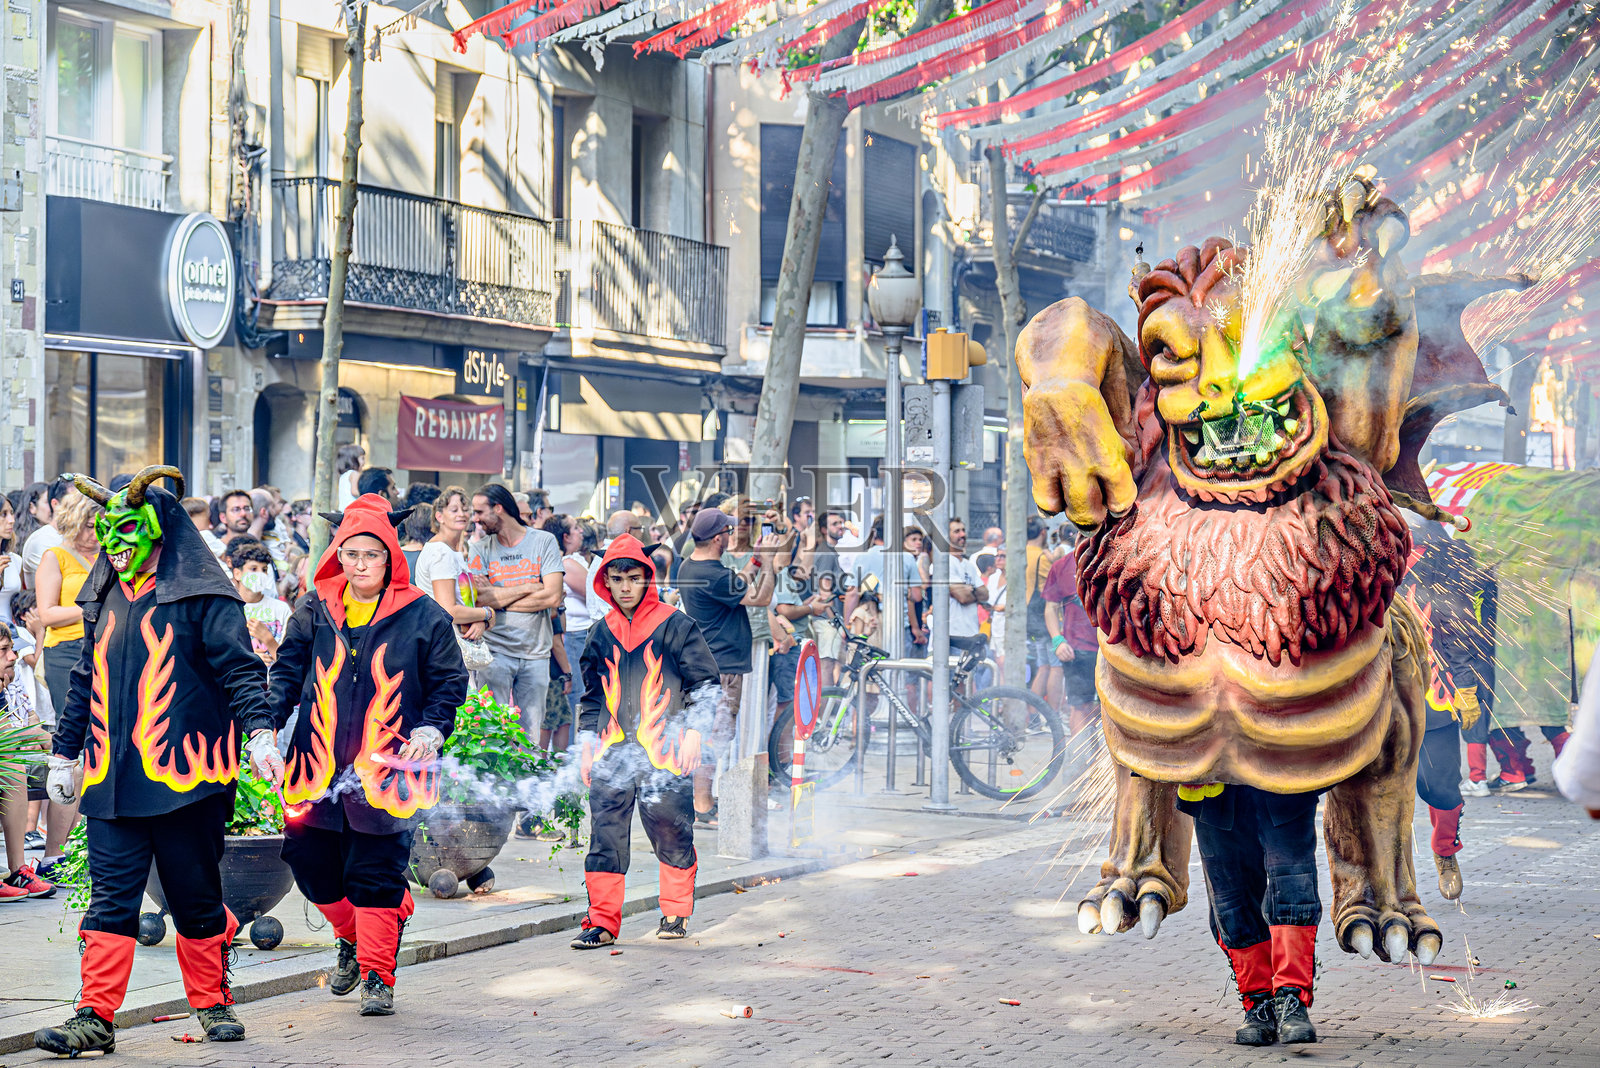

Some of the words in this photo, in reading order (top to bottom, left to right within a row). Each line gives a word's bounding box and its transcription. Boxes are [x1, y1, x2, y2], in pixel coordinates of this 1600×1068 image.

[415, 406, 497, 442] REBAIXES
[500, 553, 523, 561] VINTAGE
[872, 675, 919, 728] ROCKRIDER
